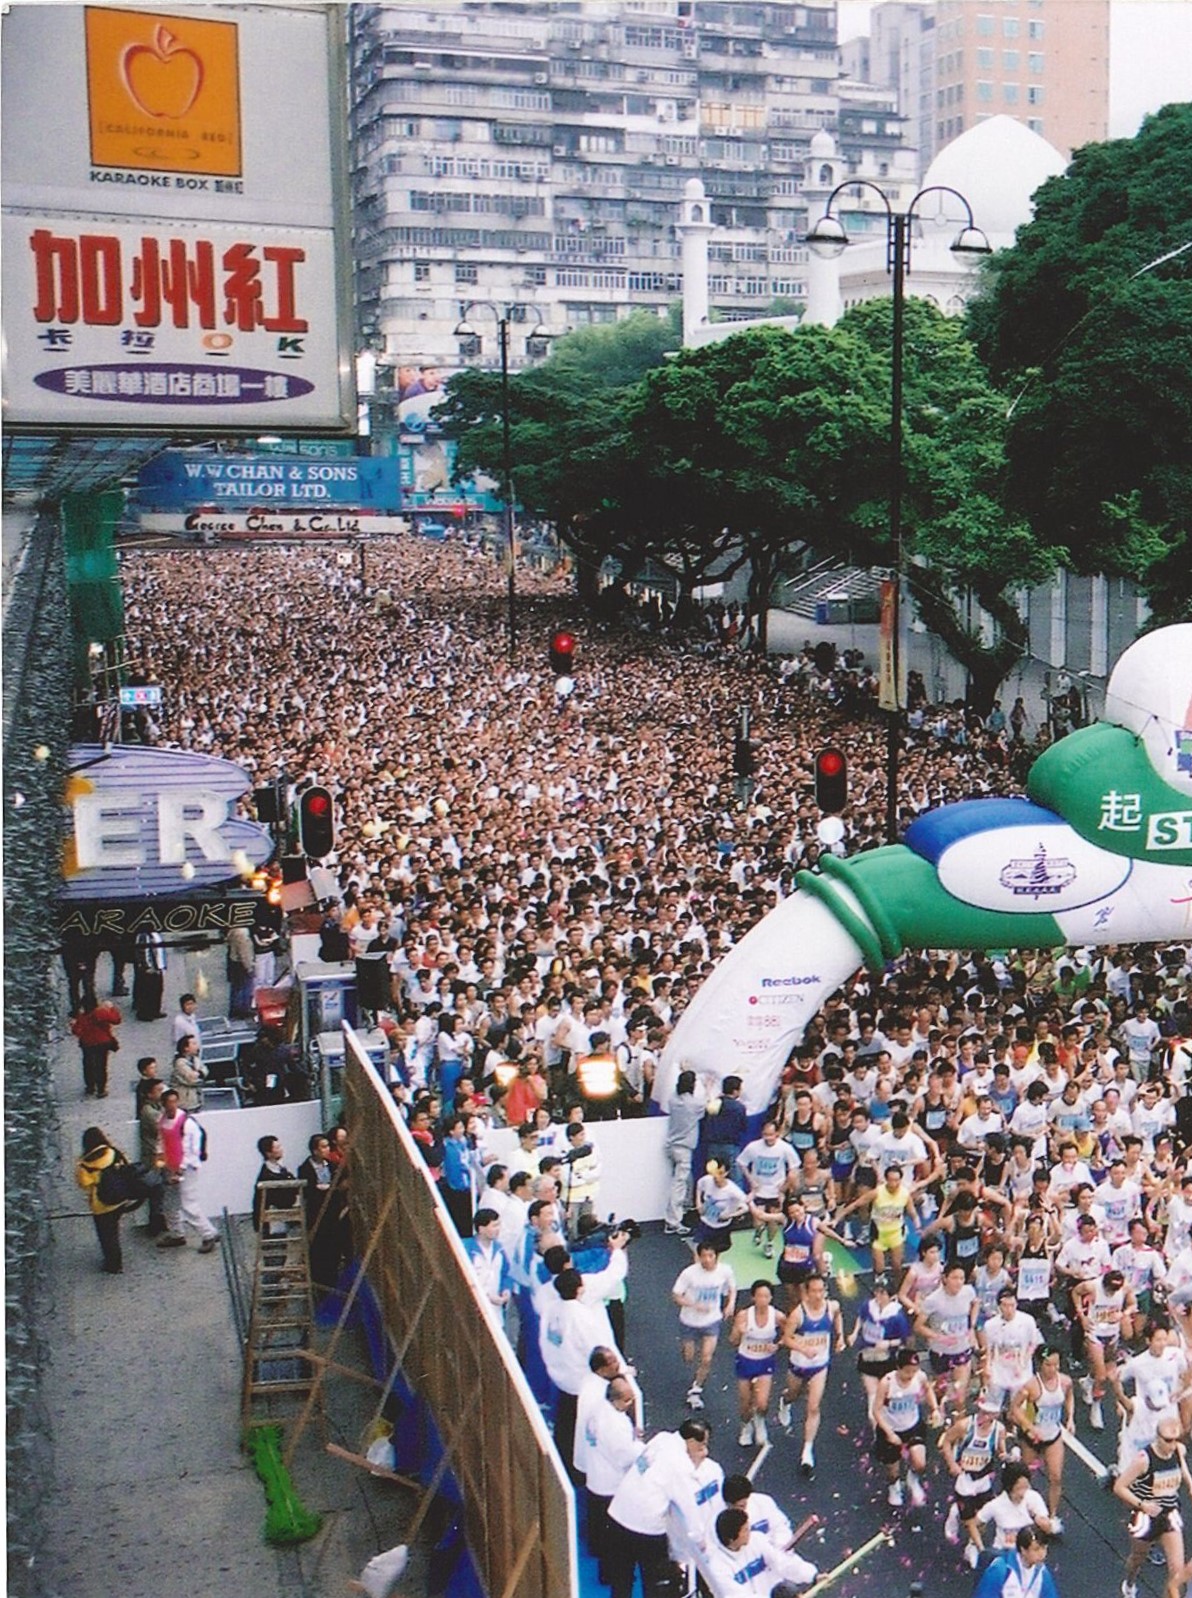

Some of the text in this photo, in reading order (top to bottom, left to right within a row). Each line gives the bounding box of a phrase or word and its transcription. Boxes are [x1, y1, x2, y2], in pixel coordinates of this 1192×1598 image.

[106, 124, 226, 142] CALIFORNIA RED
[90, 171, 171, 187] KARAOKE
[175, 177, 209, 190] BOX
[30, 229, 309, 333] 加州紅
[288, 466, 302, 480] &
[307, 466, 358, 481] SONS
[213, 483, 332, 499] TAILOR LTD.
[1098, 790, 1141, 832] 起
[761, 975, 822, 987] Reebok
